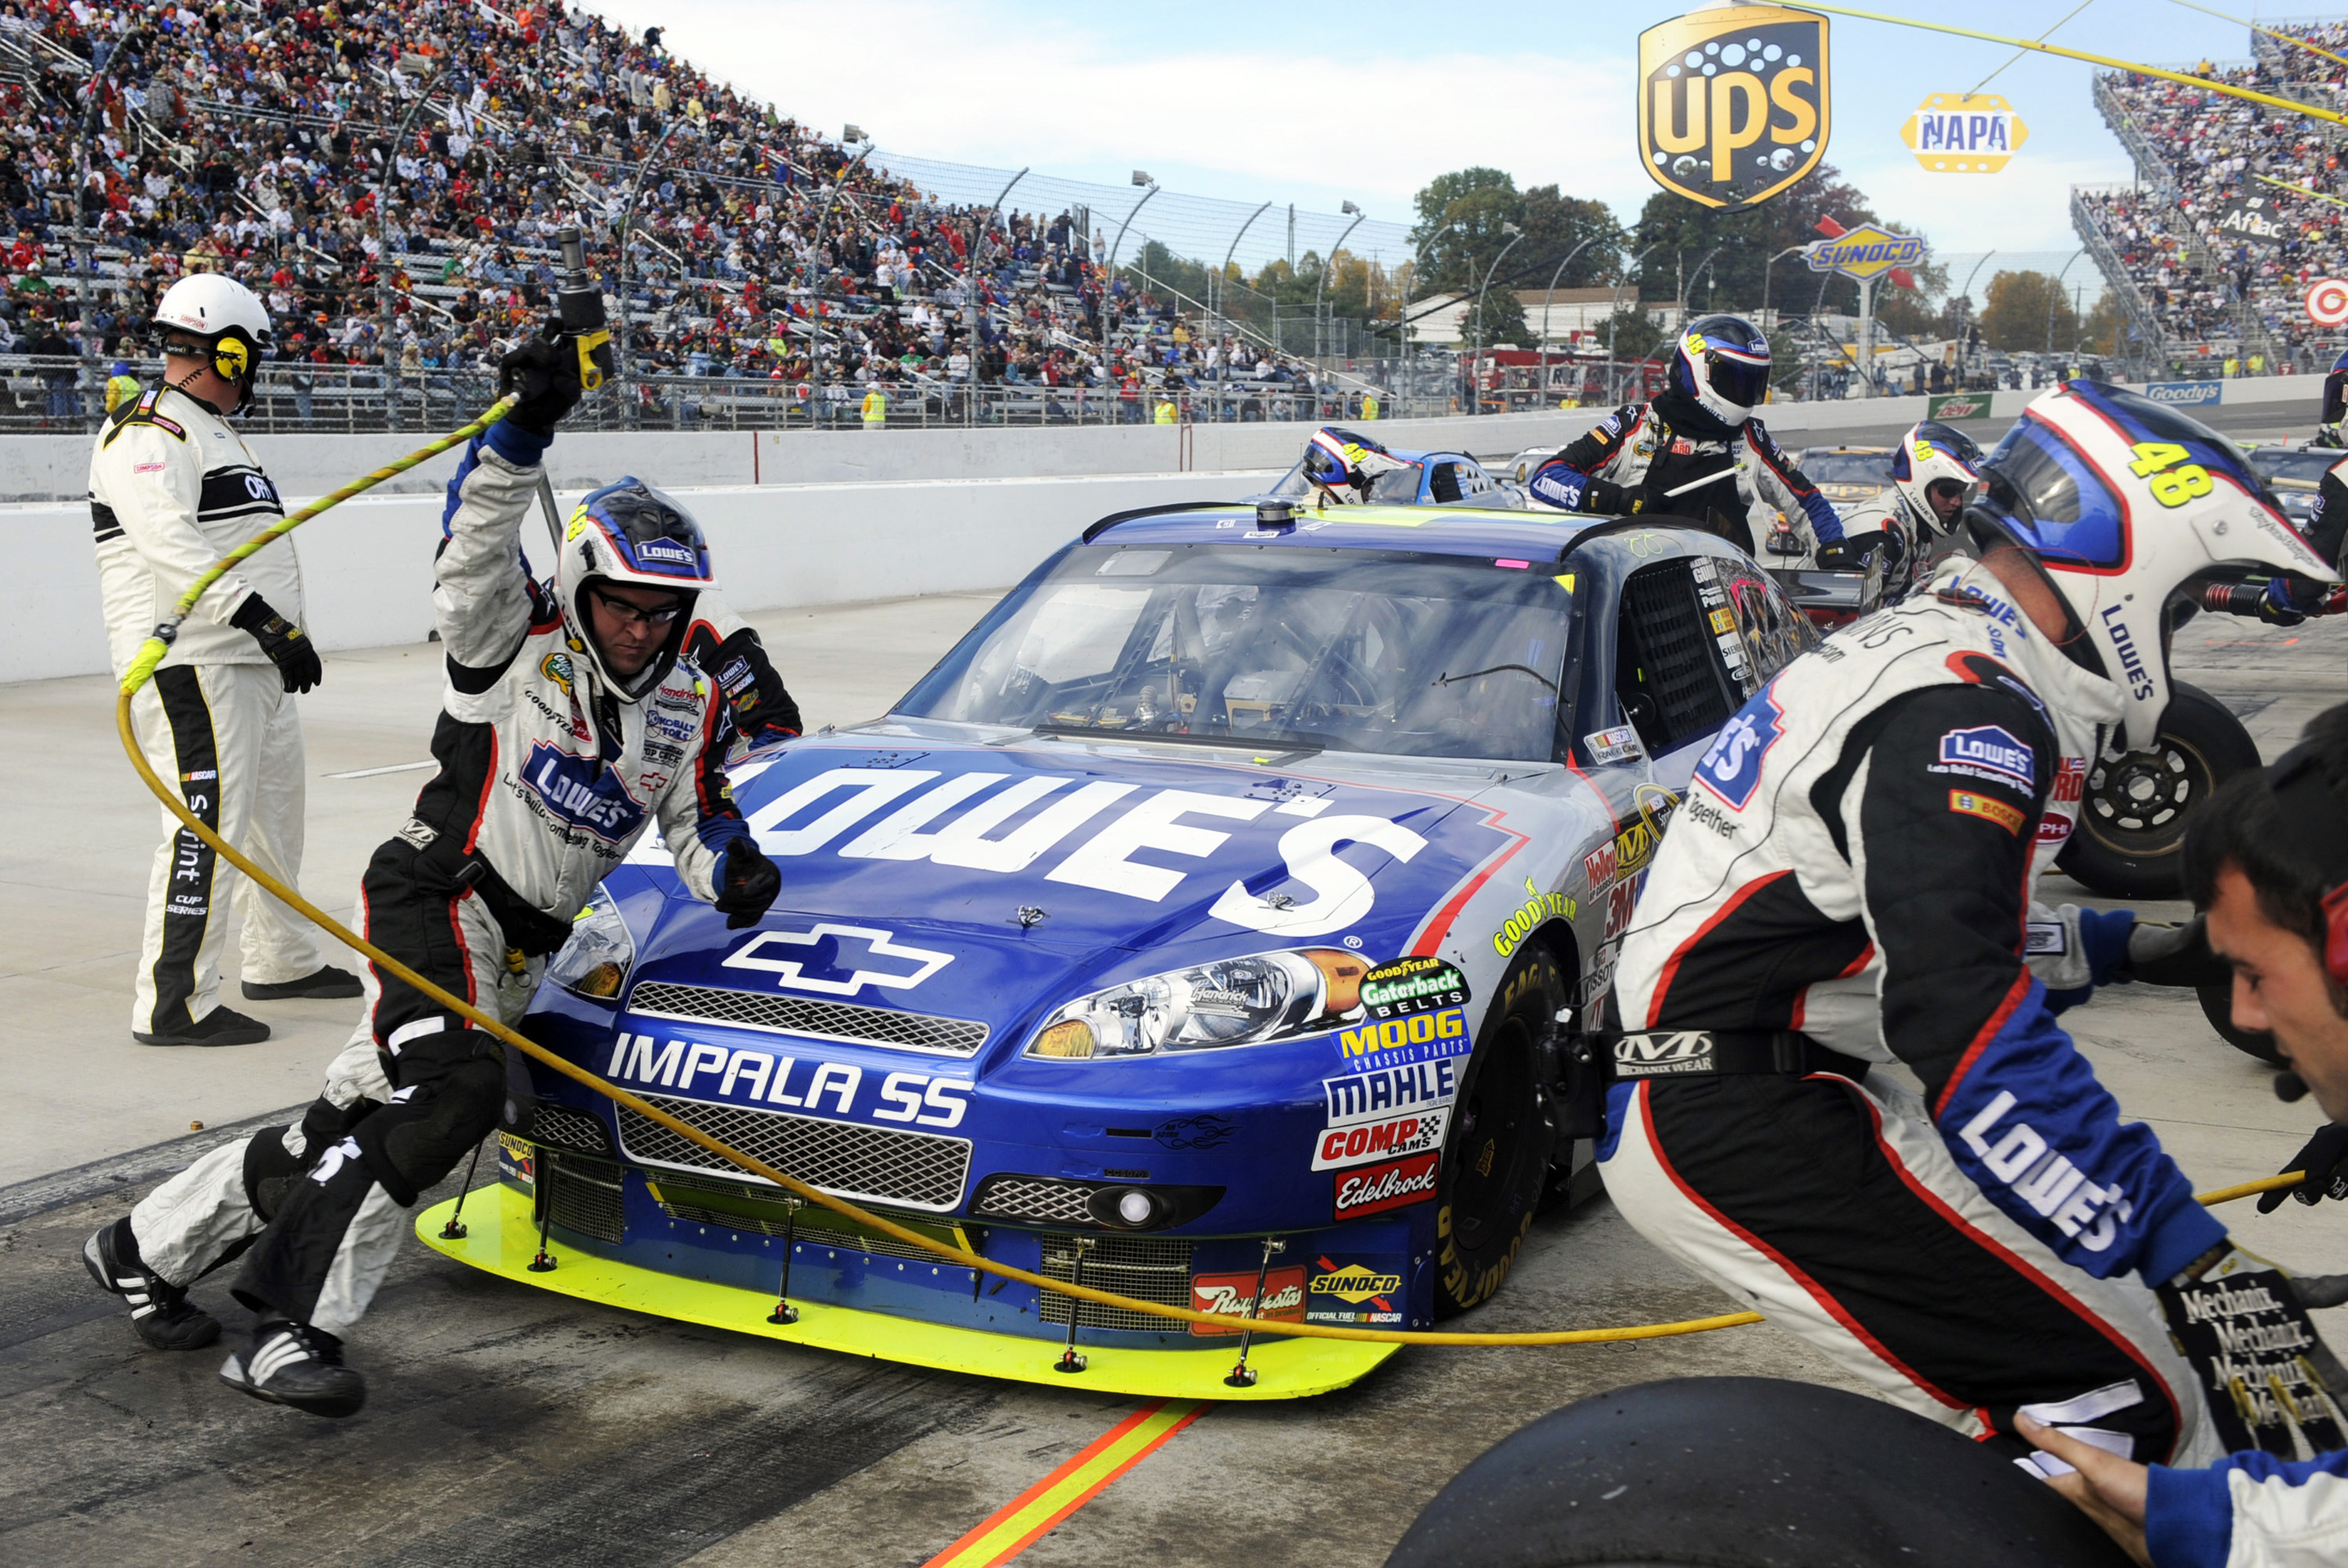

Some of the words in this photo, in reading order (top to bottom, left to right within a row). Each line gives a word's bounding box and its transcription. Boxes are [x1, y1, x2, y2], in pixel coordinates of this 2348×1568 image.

[1654, 67, 1816, 181] ups
[1922, 115, 2007, 151] NAPA
[2246, 198, 2263, 209] 99
[2223, 209, 2284, 238] Aflac
[1816, 242, 1918, 264] SUNOCO
[180, 314, 205, 328] SIMPSON
[1687, 333, 1706, 355] 48
[2149, 382, 2220, 403] Goody's
[1343, 443, 1367, 463] 48
[1914, 441, 1934, 461] 48
[1532, 472, 1581, 507] LOWE'S
[2129, 441, 2213, 507] 48
[1909, 491, 1935, 521] LOWE'S
[568, 503, 588, 542] 48
[642, 545, 693, 563] LOWE'S
[2101, 604, 2154, 702] LOWE'S
[718, 659, 743, 683] LOWE'S
[1955, 735, 2030, 773] LOWE'S
[190, 770, 216, 780] NASCAR
[536, 757, 629, 829] LOWE'S
[1688, 792, 1737, 840] Together
[176, 794, 208, 882] Srint
[725, 760, 1429, 936] OWE'S
[1585, 849, 1615, 891] Holley
[165, 904, 208, 916] SERIES
[175, 895, 202, 905] CUP
[1493, 876, 1577, 942] GOODYEAR
[1605, 874, 1636, 939] 3M
[1367, 957, 1440, 981] GOODYEAR
[1191, 987, 1249, 1003] Hendrick
[1361, 969, 1461, 1006] Gatorback
[1376, 991, 1463, 1018] BELTS
[1339, 1009, 1463, 1058] MOOG
[1354, 1048, 1415, 1072] CHASSIS
[1423, 1039, 1464, 1058] PARTS
[1671, 1058, 1714, 1073] WEAR
[608, 1033, 863, 1114] IMPALA
[873, 1072, 975, 1128] SS
[1327, 1059, 1454, 1118] MAHLE
[500, 1133, 533, 1157] SUNOCO
[1321, 1118, 1419, 1160] COMP
[1387, 1138, 1431, 1155] CAMS
[1336, 1163, 1435, 1210] Edelbrock
[1957, 1090, 2134, 1252] LOWE'S
[1314, 1276, 1399, 1292] SUNOCO
[1307, 1312, 1336, 1320] OFFICIAL
[1338, 1312, 1355, 1320] FUEL
[1369, 1312, 1401, 1323] NASCAR
